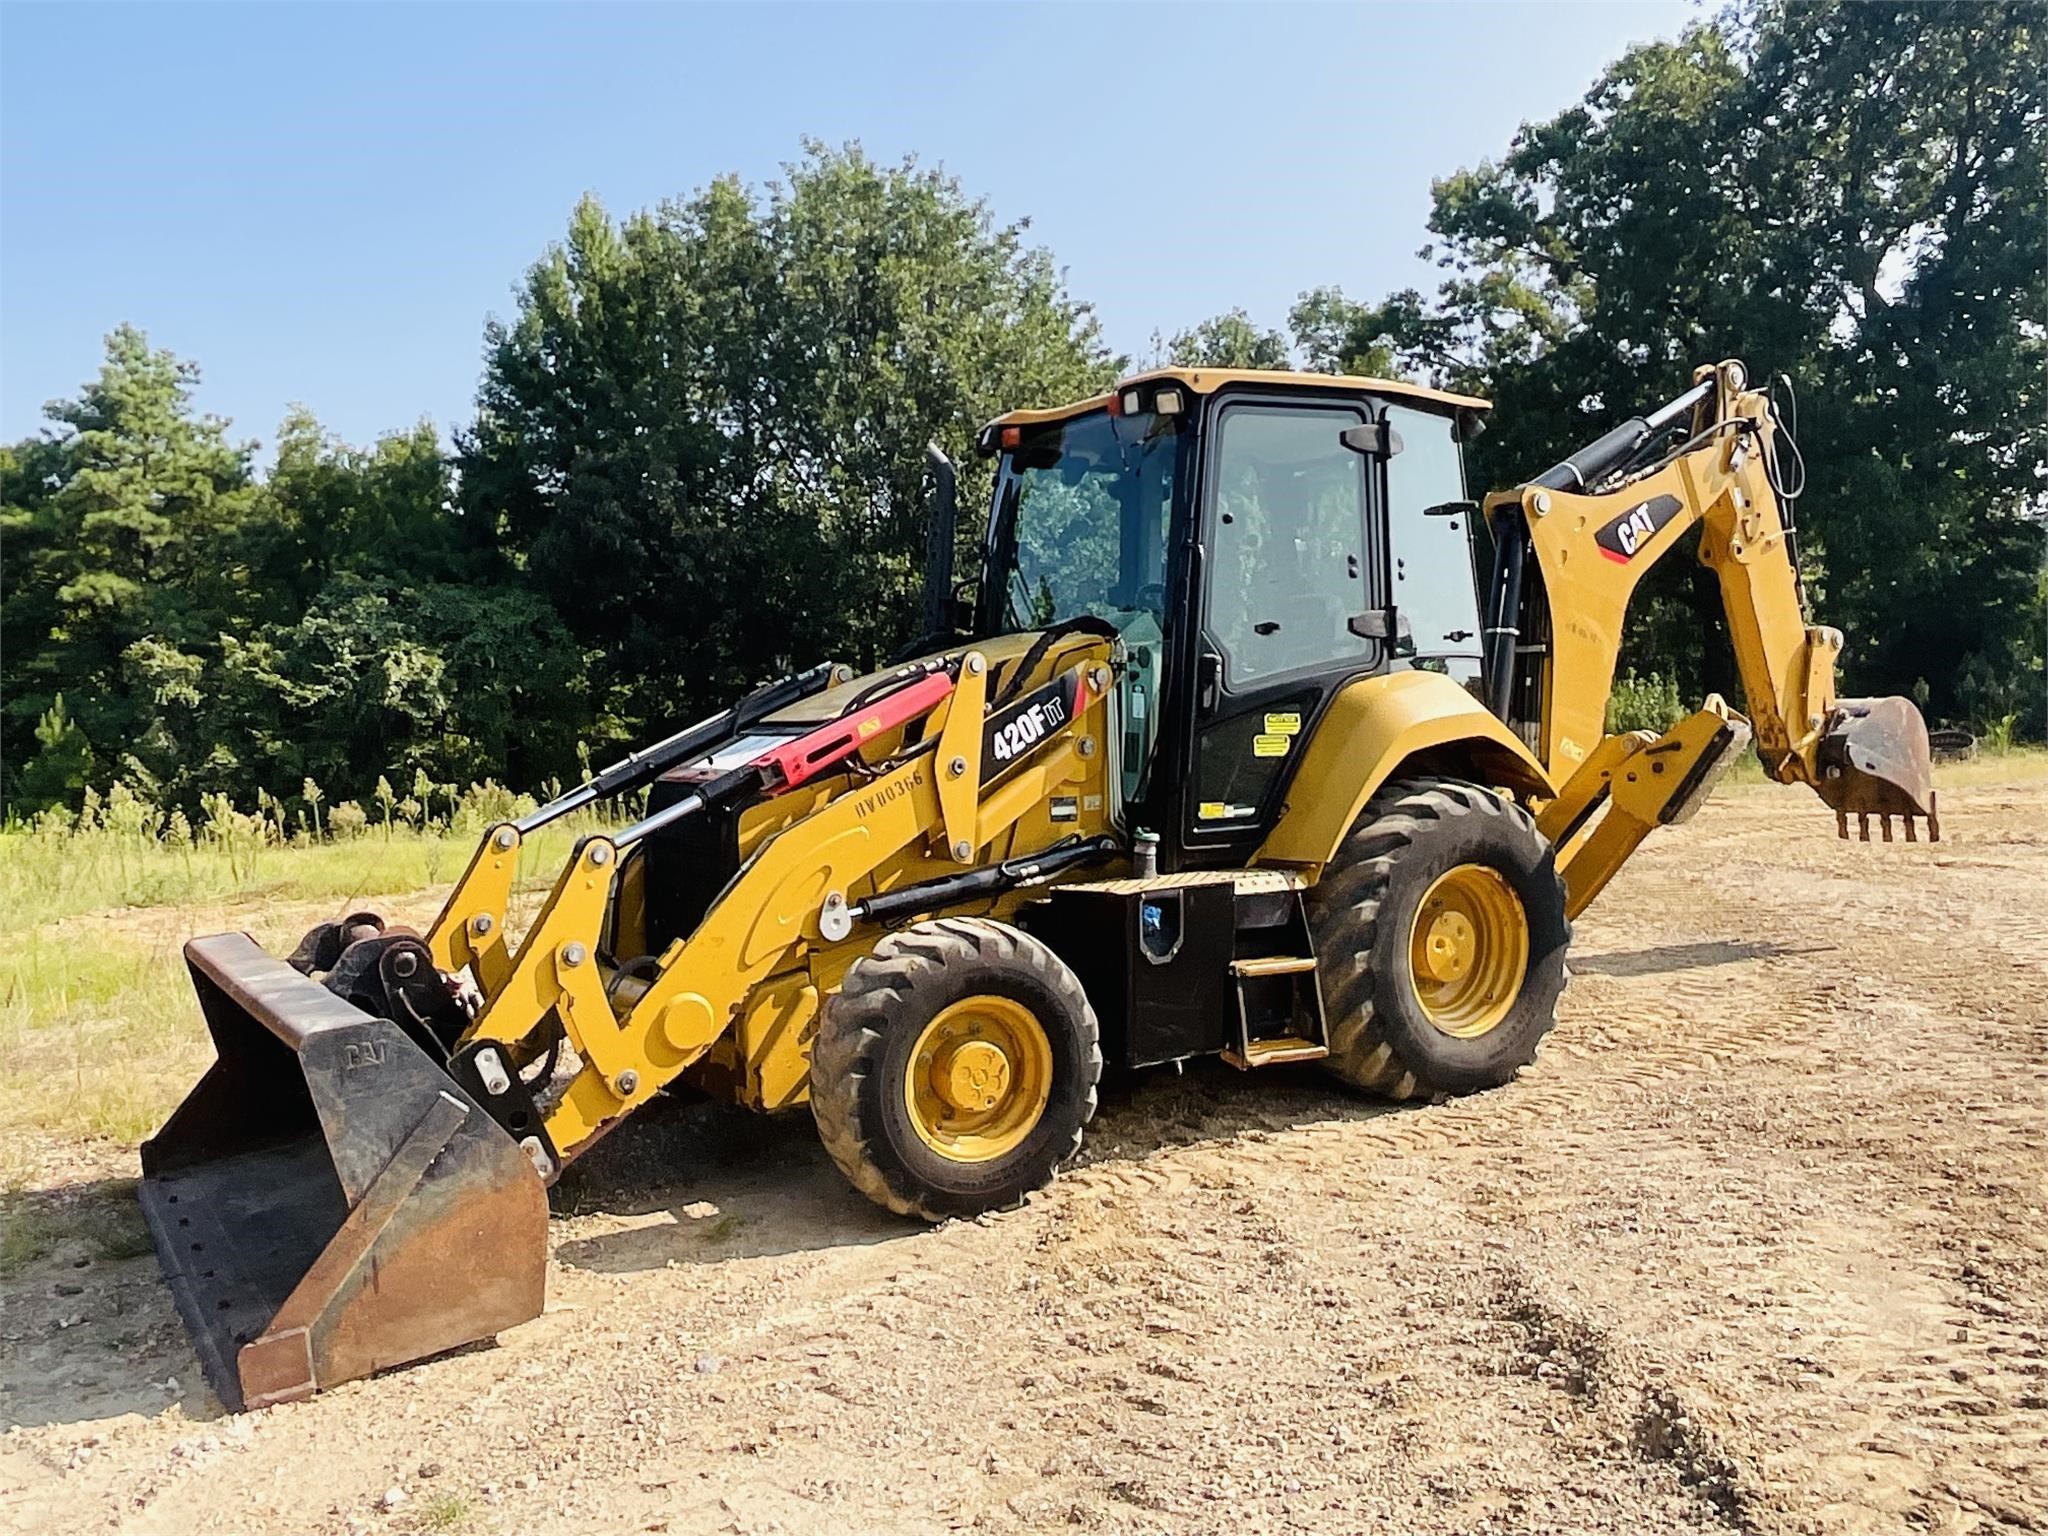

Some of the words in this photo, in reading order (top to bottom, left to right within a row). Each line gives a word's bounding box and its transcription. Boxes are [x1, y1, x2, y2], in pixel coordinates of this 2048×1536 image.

[1617, 502, 1656, 555] CAT
[994, 703, 1045, 760] 420F
[1042, 696, 1065, 727] IT
